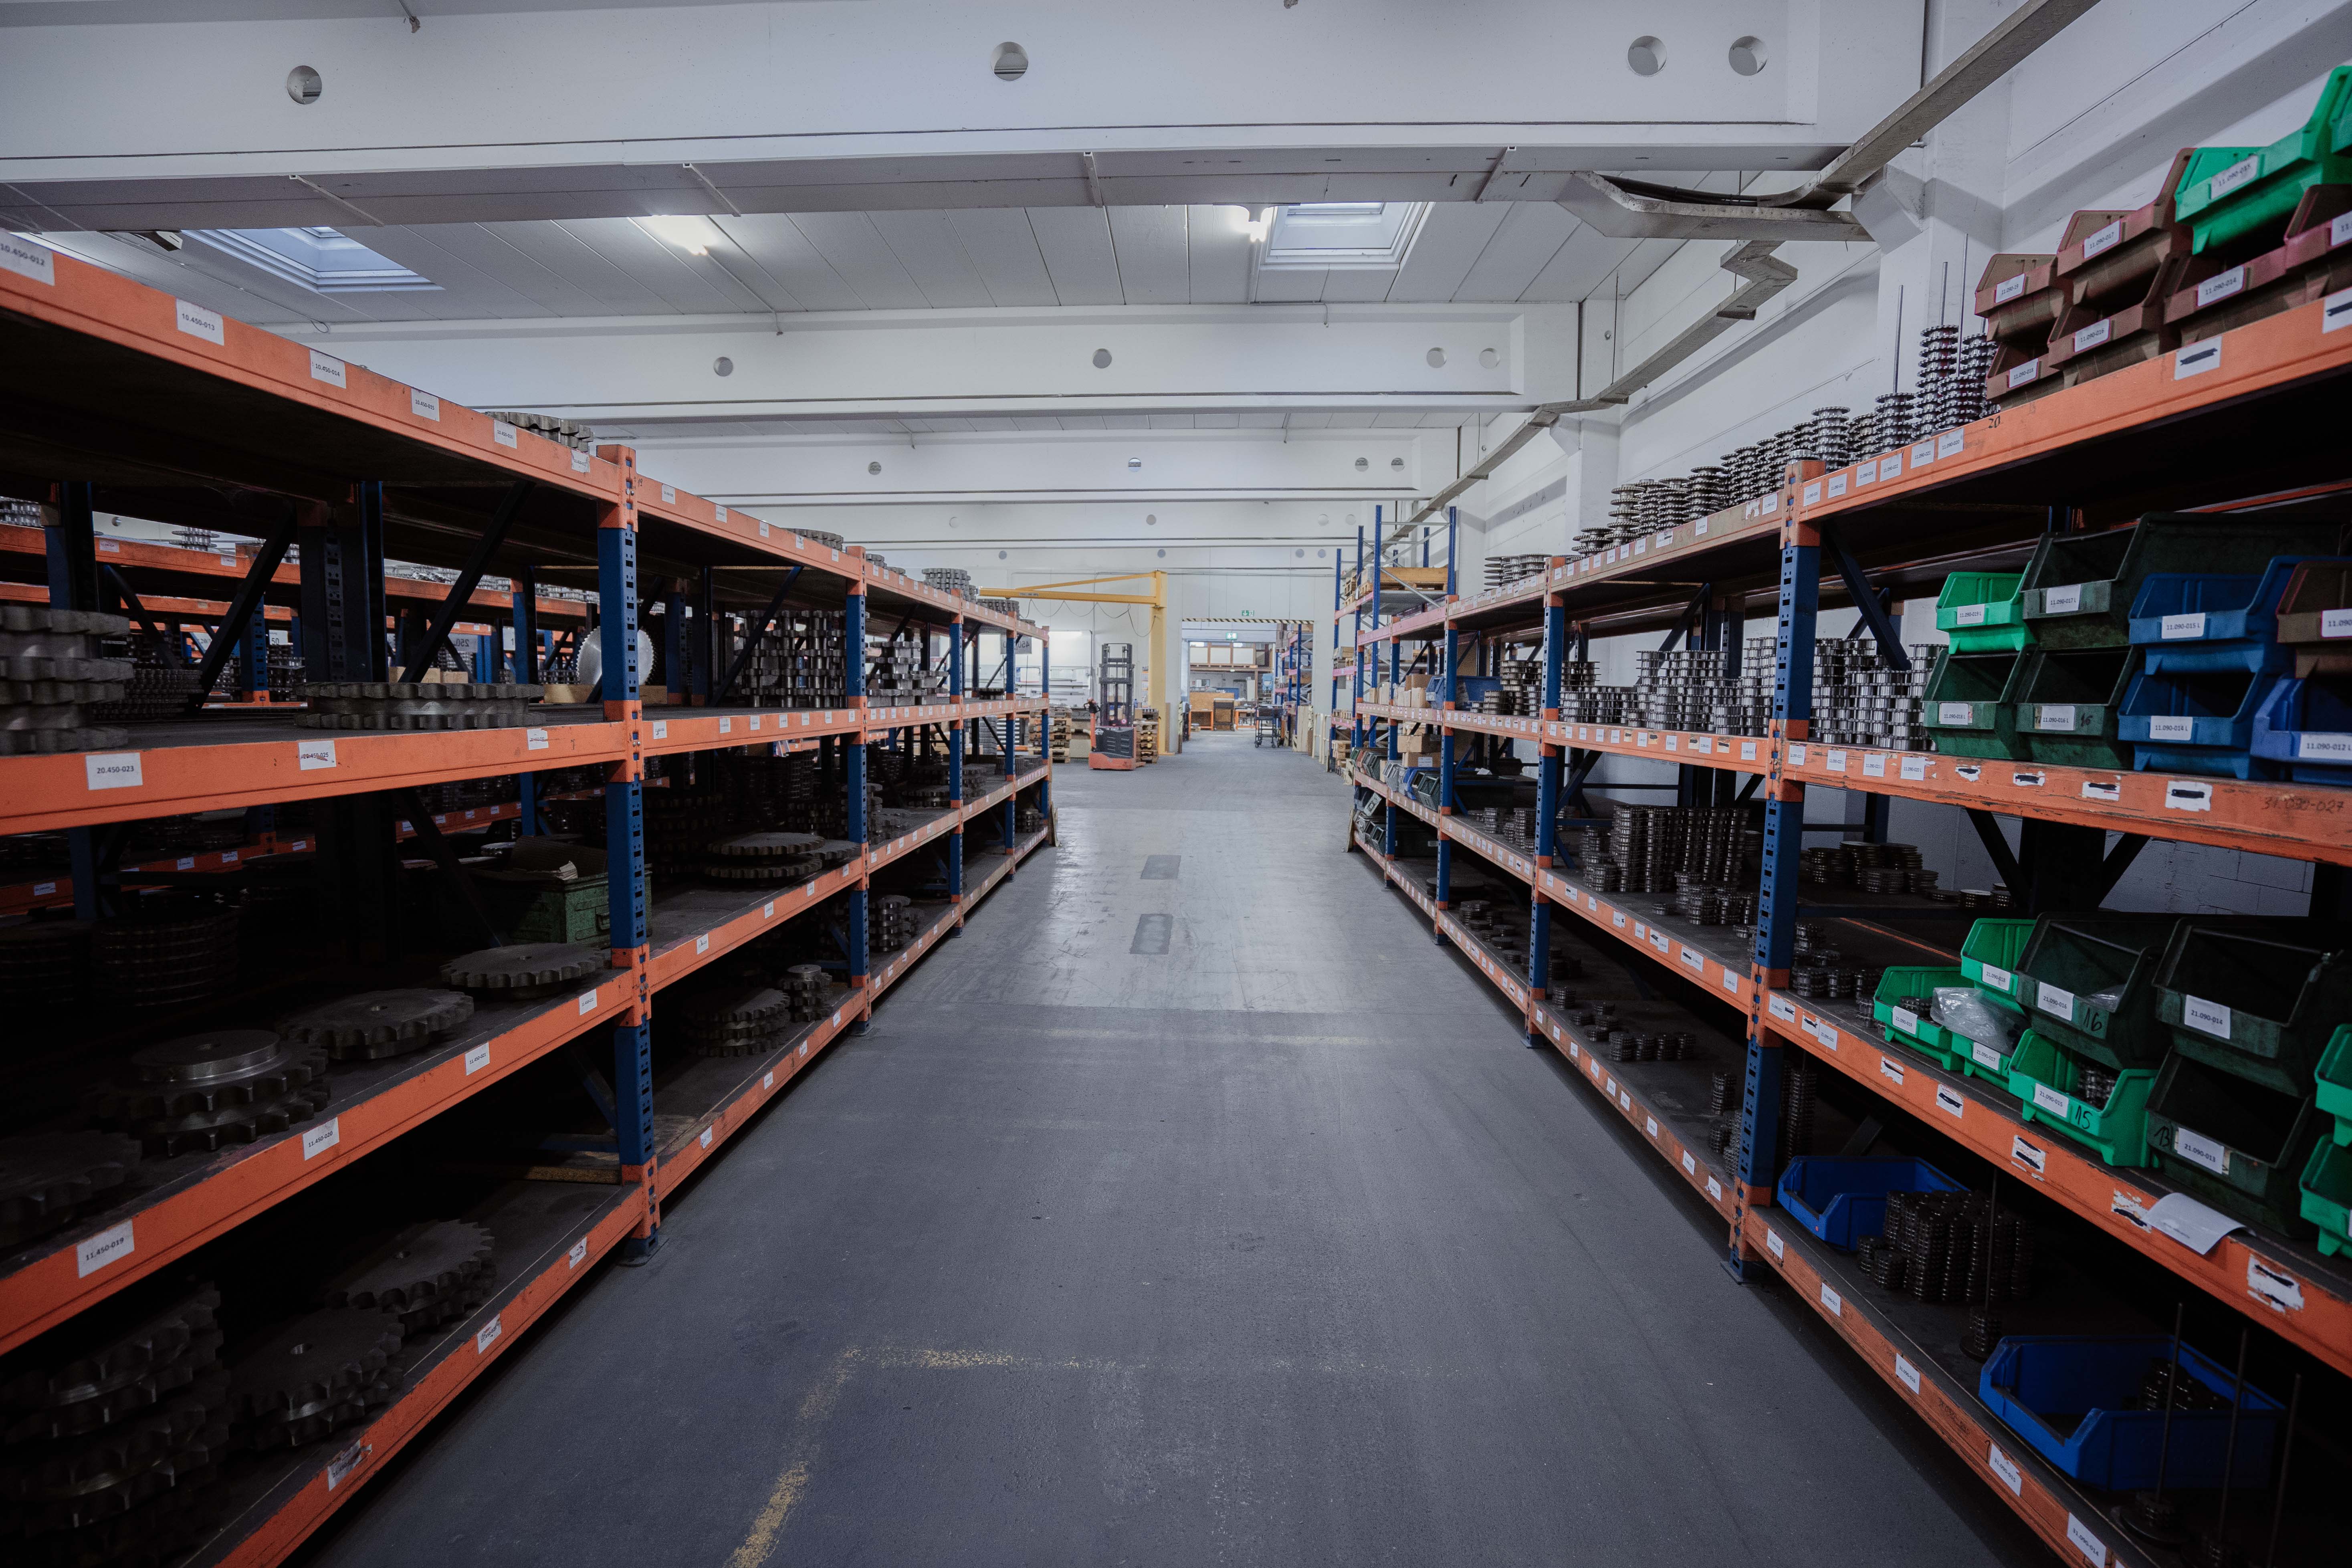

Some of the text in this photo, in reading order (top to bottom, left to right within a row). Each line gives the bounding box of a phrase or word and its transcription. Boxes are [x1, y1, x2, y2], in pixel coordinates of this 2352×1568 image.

[2090, 232, 2114, 249] 11.090-017
[2001, 284, 2019, 295] 11.090-19
[2205, 277, 2237, 295] 11.090-014
[182, 313, 215, 331] 10.450-013
[315, 363, 340, 377] 10.450-014
[2013, 367, 2034, 379] 11.090-018
[415, 400, 435, 410] 10.450-015
[1988, 416, 2000, 429] 20
[1942, 440, 1960, 450] 11.090-020
[1914, 451, 1931, 459] 11.090-021
[1883, 464, 1898, 473] 11.090-022
[2081, 712, 2093, 727] 16
[2307, 743, 2346, 751] 11.090-012
[97, 766, 134, 774] 20.450-023
[1986, 971, 2006, 983] 21.090-018
[2043, 996, 2067, 1009] 21.090-016
[1896, 1016, 1912, 1027] 21.090-019
[2086, 1007, 2102, 1031] 16
[2191, 1010, 2223, 1025] 21.090-014
[1821, 1032, 1834, 1043] 21.090-020
[470, 1053, 486, 1065] 11.450-021
[1976, 1049, 1995, 1062] 21.090-017
[2039, 1091, 2063, 1107] 21.090-015
[2075, 1105, 2093, 1130] 15
[308, 1131, 333, 1148] 11.450-020
[2154, 1126, 2170, 1147] 13
[2184, 1144, 2216, 1162] 21.090-013
[85, 1237, 125, 1261] 11.450-019
[1899, 1365, 1916, 1383] 31.090-016
[1994, 1458, 2016, 1483] 31.090-015
[2072, 1528, 2100, 1556] 31.090-014
